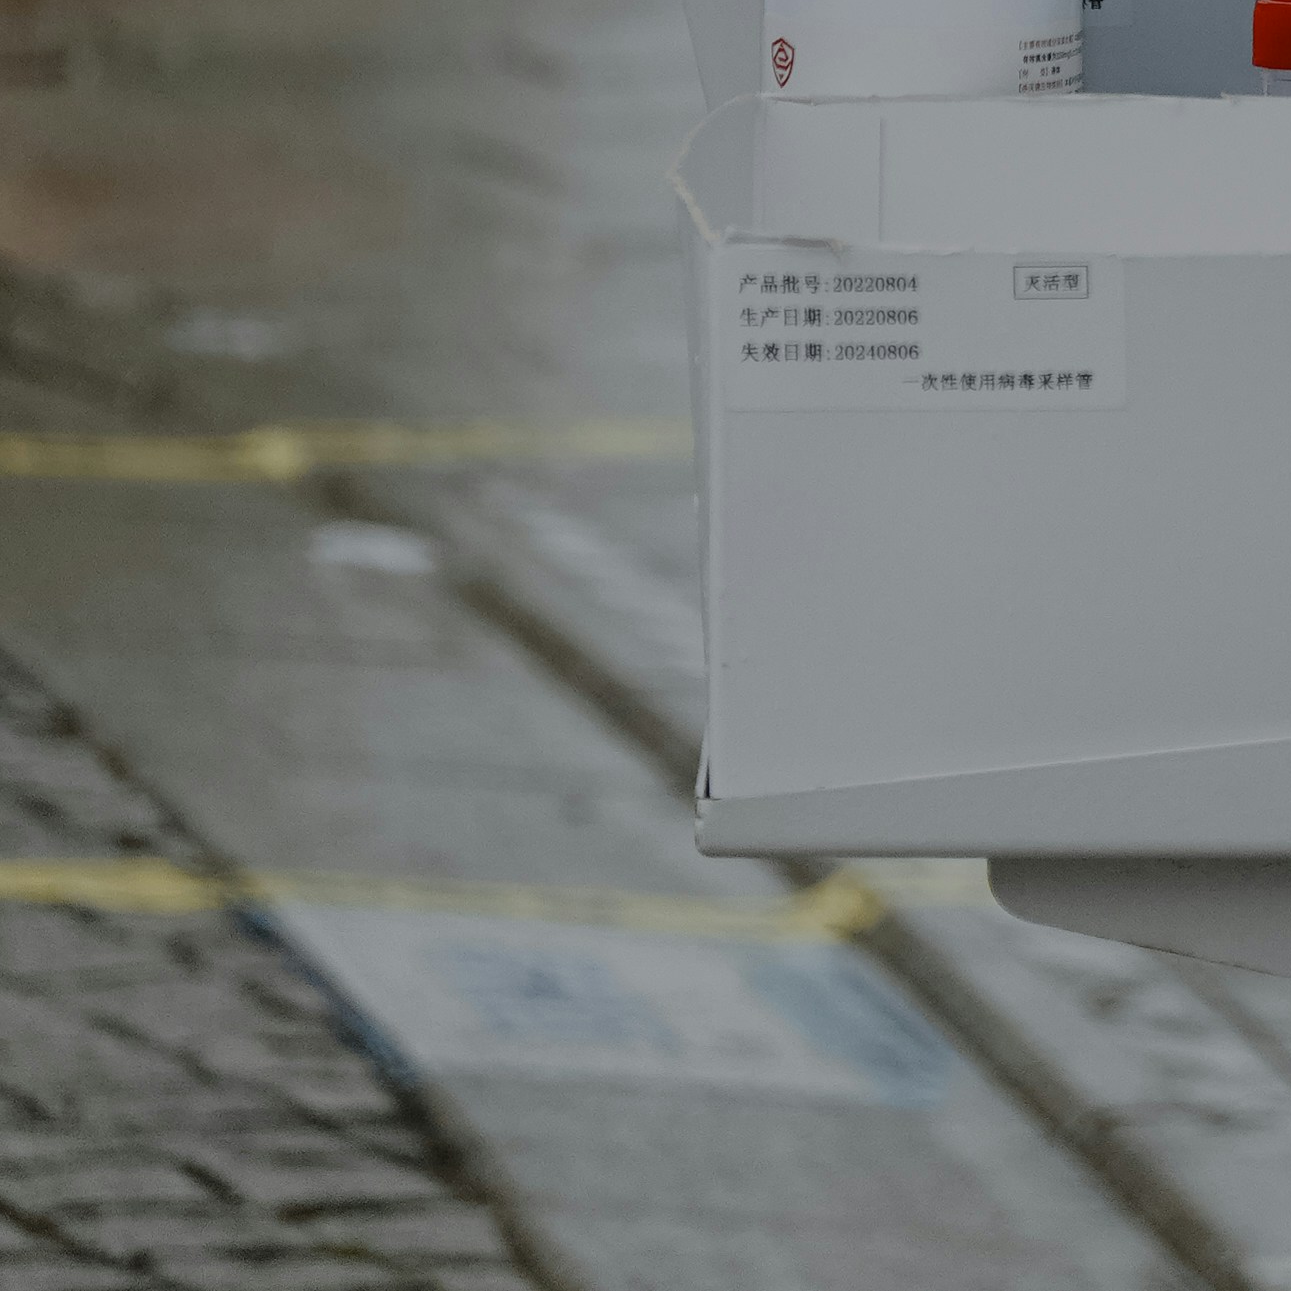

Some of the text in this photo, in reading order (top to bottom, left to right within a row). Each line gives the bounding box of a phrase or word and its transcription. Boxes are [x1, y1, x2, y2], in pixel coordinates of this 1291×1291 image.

[738, 274, 919, 294] 产品批号:20220804
[1023, 273, 1081, 293] 灭活型
[739, 307, 920, 328] 生产日期:20220806
[740, 343, 920, 363] 失效日期:20240806
[902, 372, 1094, 392] 一次性使用病毒采样管
